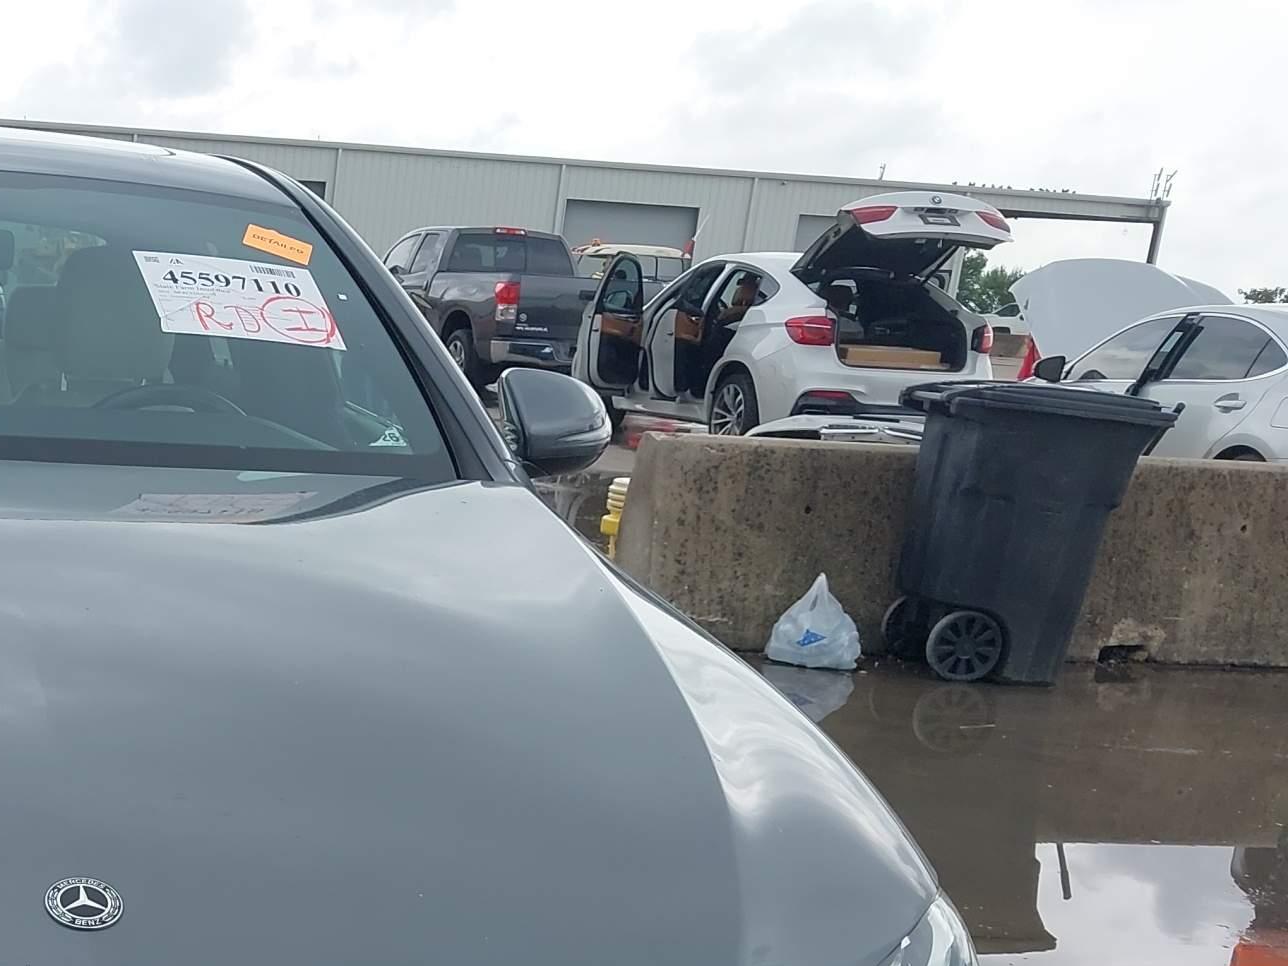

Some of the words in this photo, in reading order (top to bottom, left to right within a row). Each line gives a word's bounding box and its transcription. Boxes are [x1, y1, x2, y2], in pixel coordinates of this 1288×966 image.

[162, 269, 301, 297] 45597110
[56, 879, 106, 889] MERCEDES
[74, 918, 102, 926] BENZ
